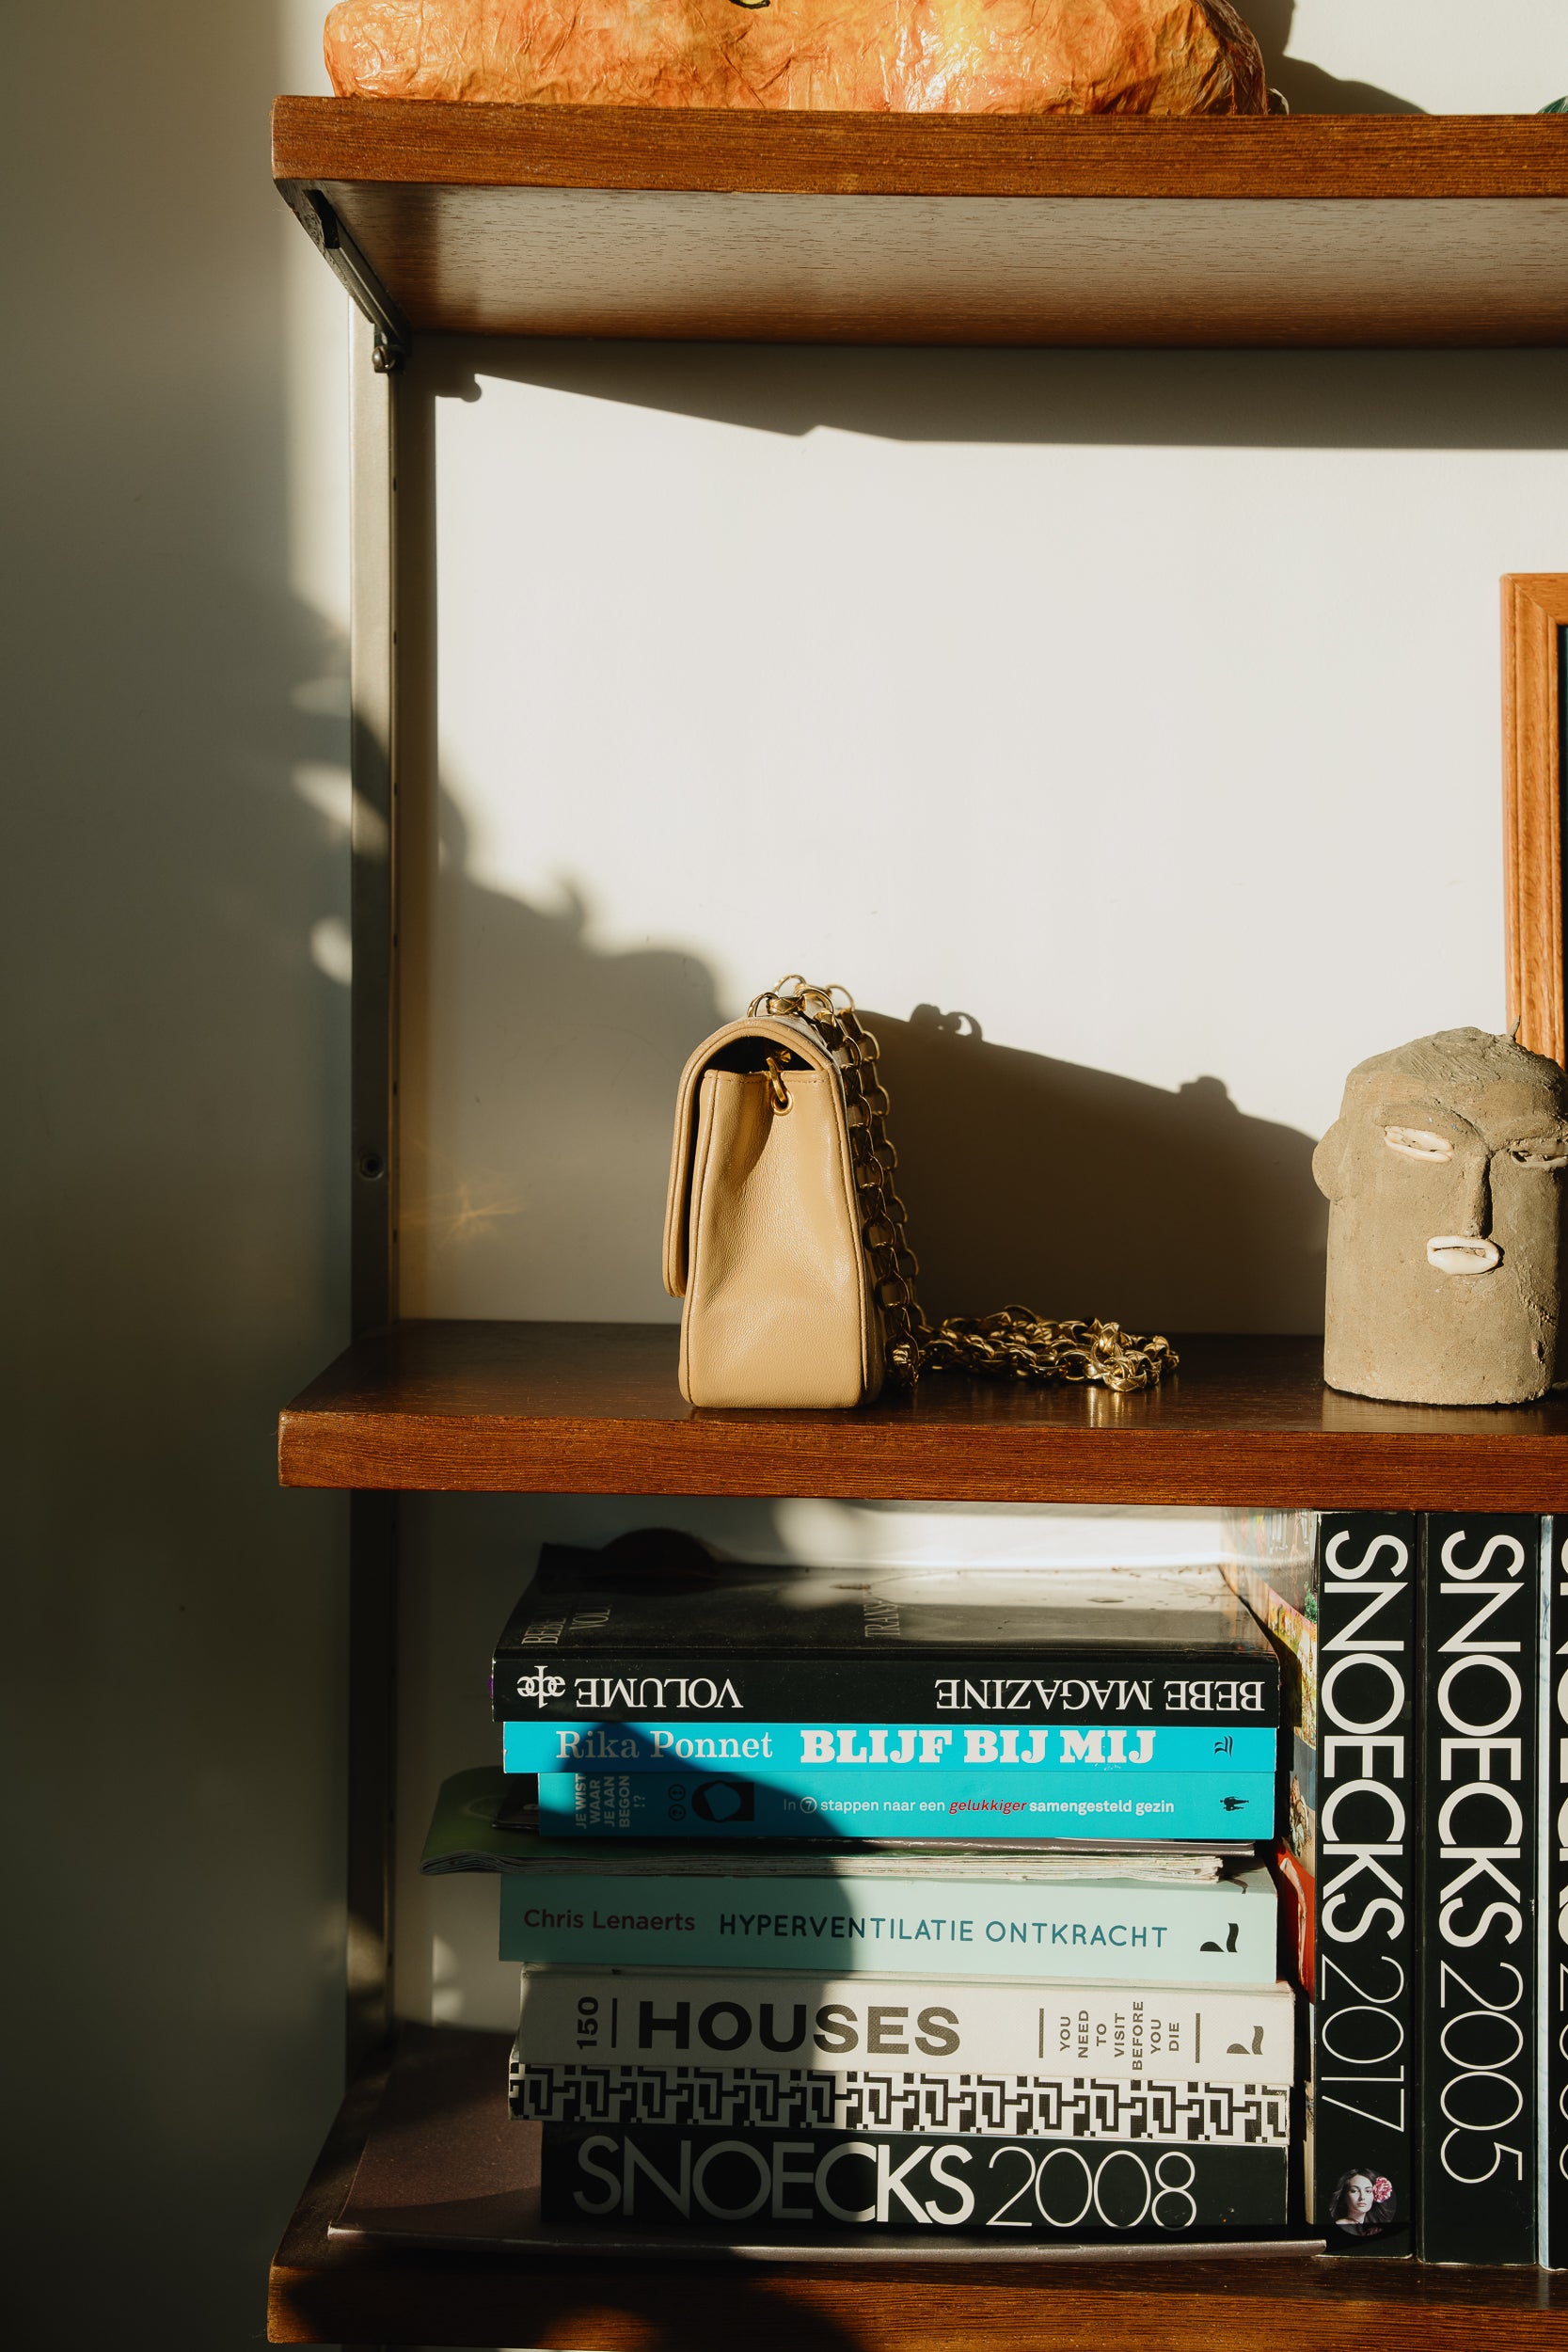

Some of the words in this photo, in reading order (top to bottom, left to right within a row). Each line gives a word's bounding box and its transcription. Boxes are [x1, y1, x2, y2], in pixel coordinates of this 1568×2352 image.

[575, 1677, 743, 1708] VOLUME
[934, 1678, 1153, 1710] MAGAZINE
[1163, 1680, 1266, 1711] BEBE
[555, 1730, 640, 1759] Rika
[650, 1730, 773, 1759] Ponnet
[800, 1728, 953, 1764] BLIJF
[963, 1728, 1051, 1764] BIJ
[1059, 1729, 1157, 1764] MIJ
[1321, 1530, 1409, 1944] SNOECKS
[1437, 1530, 1525, 1948] SNOECKS
[575, 1773, 587, 1808] WIST
[590, 1778, 600, 1824] WAAR
[604, 1775, 614, 1804] AAN
[619, 1775, 630, 1827] BEGON
[783, 1798, 798, 1812] In
[820, 1798, 879, 1816] stappen
[882, 1799, 918, 1813] naar
[920, 1800, 945, 1813] een
[948, 1798, 1028, 1816] gelukkiger
[1029, 1798, 1132, 1816] samengesteld
[1135, 1799, 1175, 1816] gezin
[575, 1811, 587, 1829] JE
[604, 1808, 614, 1827] JE
[523, 1908, 584, 1930] Chris
[592, 1911, 695, 1932] Lenaerts
[719, 1913, 974, 1942] HYPERVENTILATIE
[985, 1920, 1168, 1948] ONTKRACHT
[577, 1996, 598, 2050] 150
[638, 2000, 960, 2056] HOUSES
[1059, 2015, 1071, 2051] YOU
[1078, 2010, 1089, 2058] NEED
[1096, 2023, 1107, 2046] TO
[1114, 2013, 1126, 2058] VISIT
[1132, 2001, 1144, 2071] BEFORE
[1150, 2018, 1162, 2055] YOU
[1168, 2022, 1180, 2052] DIE
[1321, 1954, 1405, 2133] 2017
[1440, 1960, 1524, 2185] 2005
[573, 2135, 975, 2226] SNOECKS
[986, 2146, 1197, 2232] 2008
